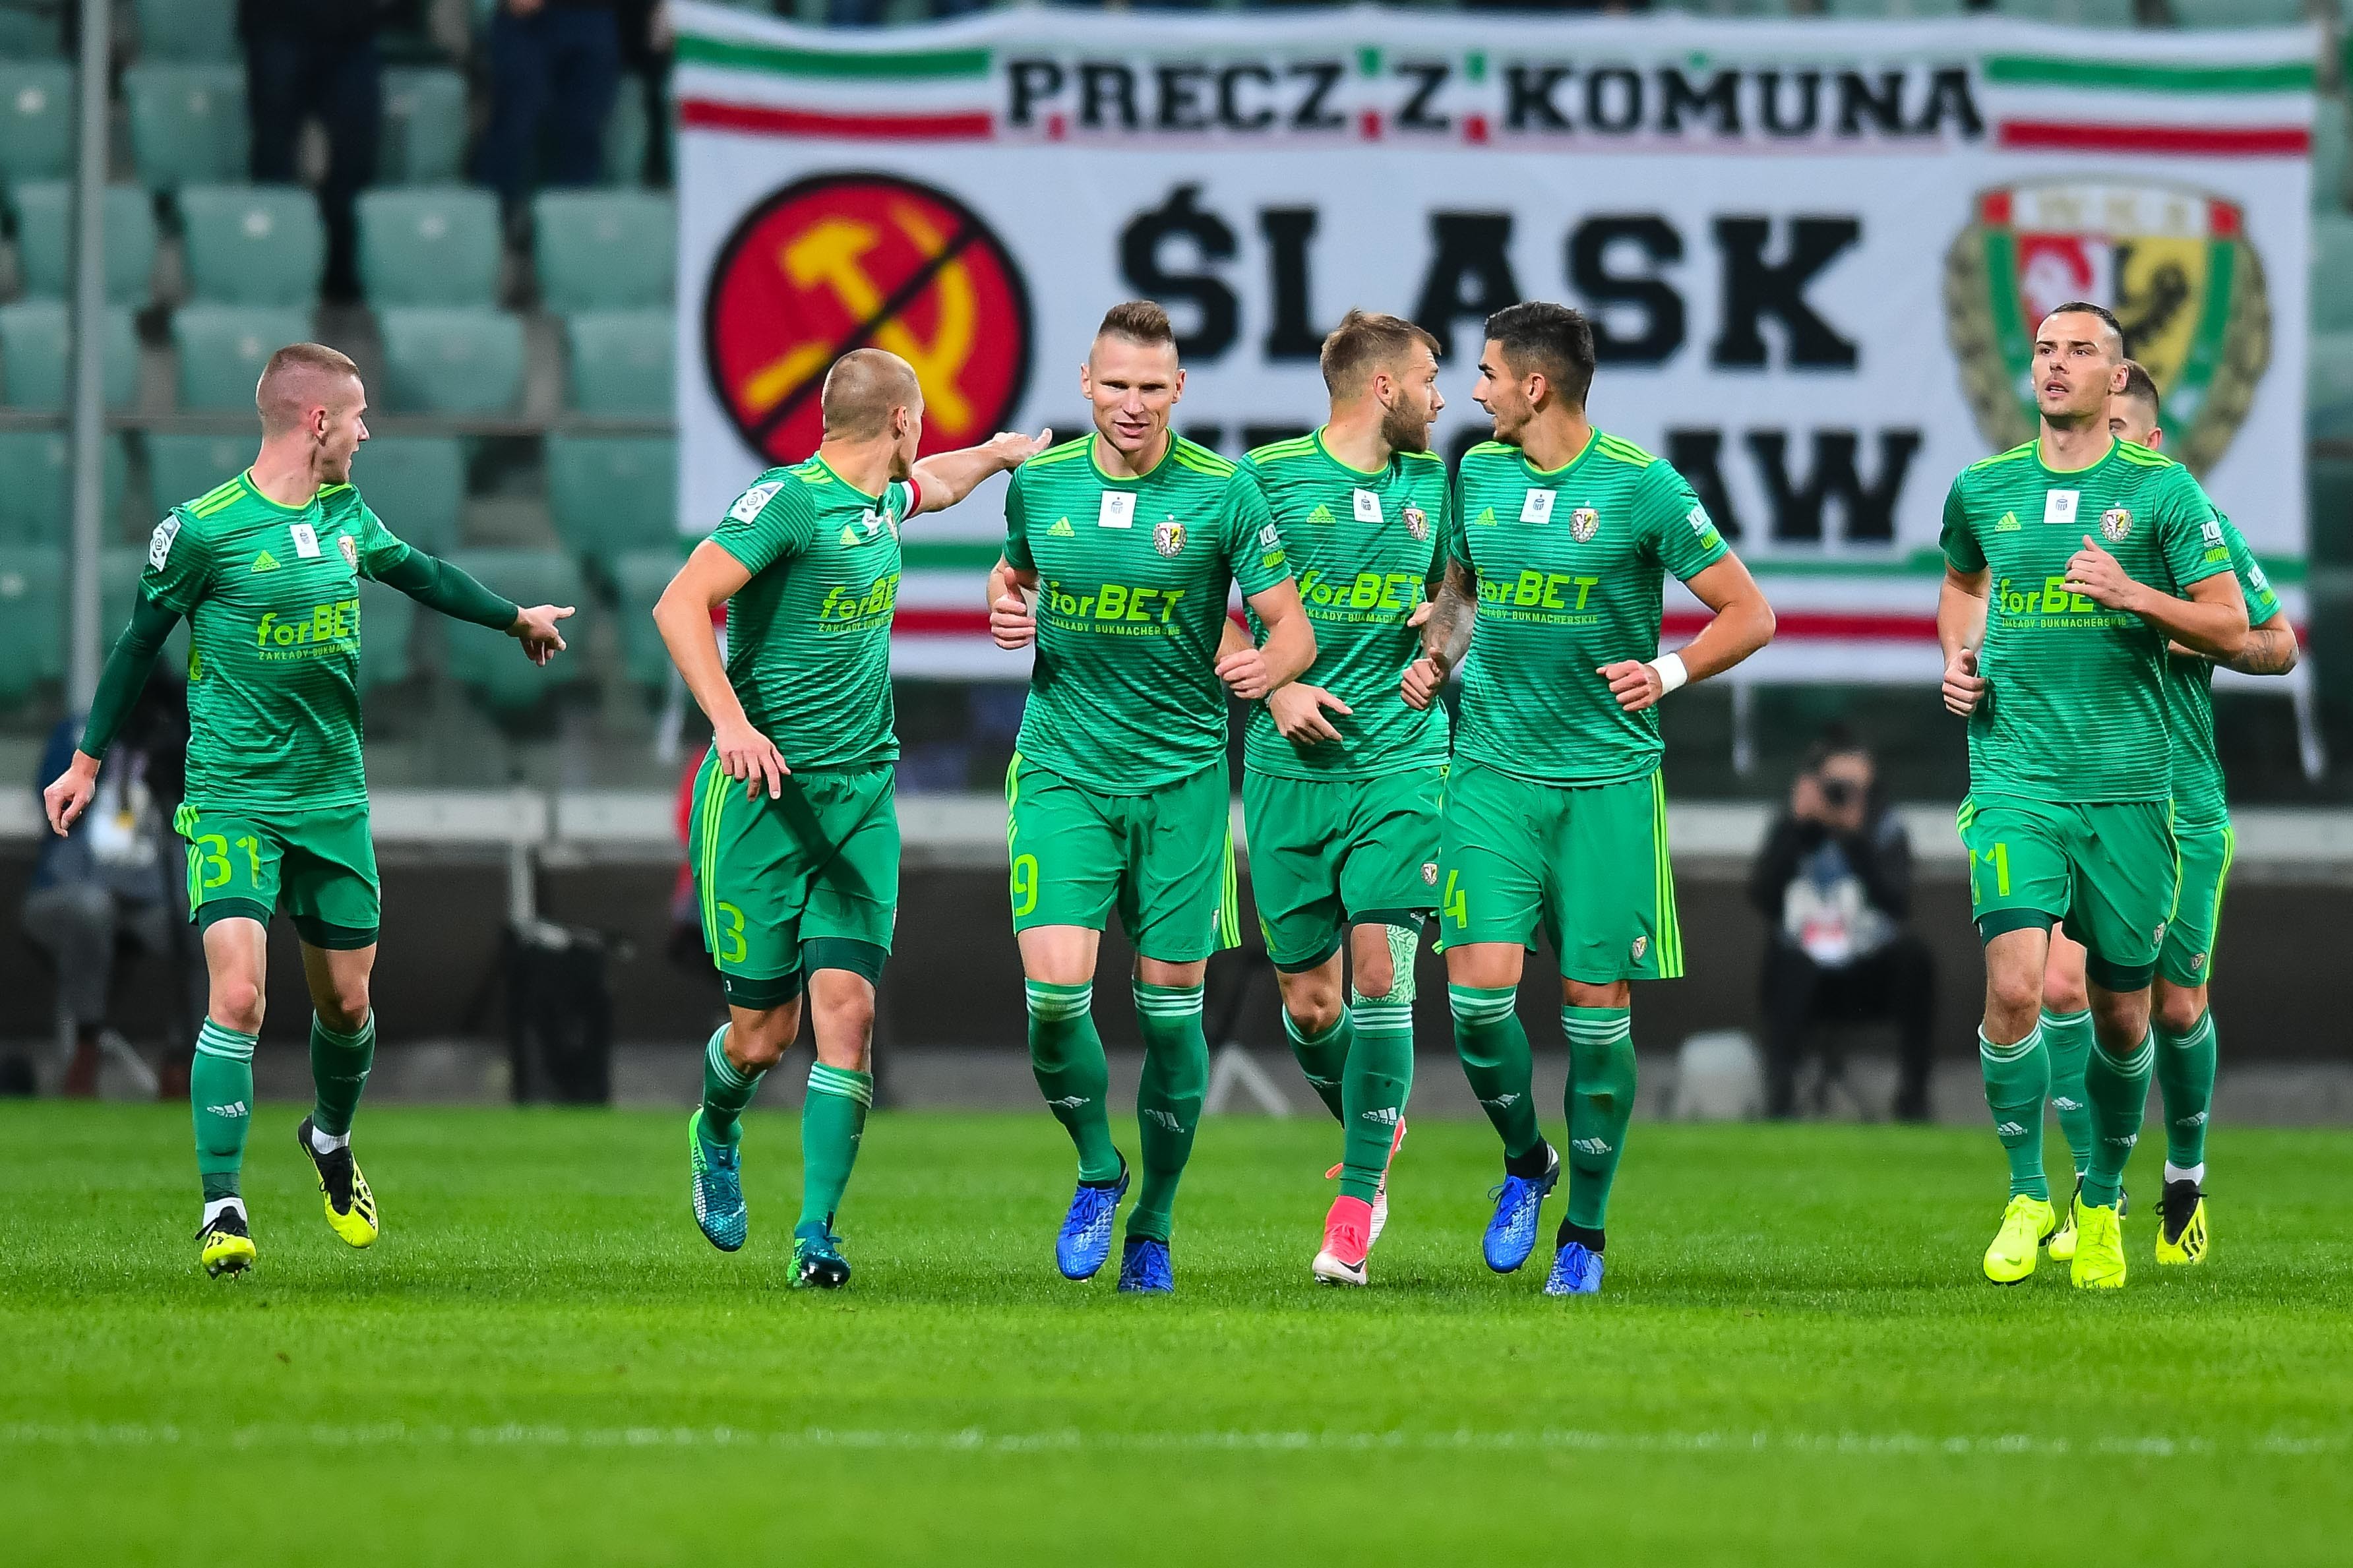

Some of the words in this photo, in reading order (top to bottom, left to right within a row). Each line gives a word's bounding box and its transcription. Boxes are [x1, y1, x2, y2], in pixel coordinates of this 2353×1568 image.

[1008, 61, 1344, 131] PRECZ
[1393, 64, 1452, 131] Z
[820, 572, 901, 618] forBE
[1050, 581, 1186, 623] forBET
[1299, 570, 1423, 611] forBET
[2000, 576, 2104, 613] forBE
[197, 833, 259, 889] 31
[1013, 853, 1038, 917] 9
[1444, 869, 1467, 929] 4
[718, 902, 747, 963] 3
